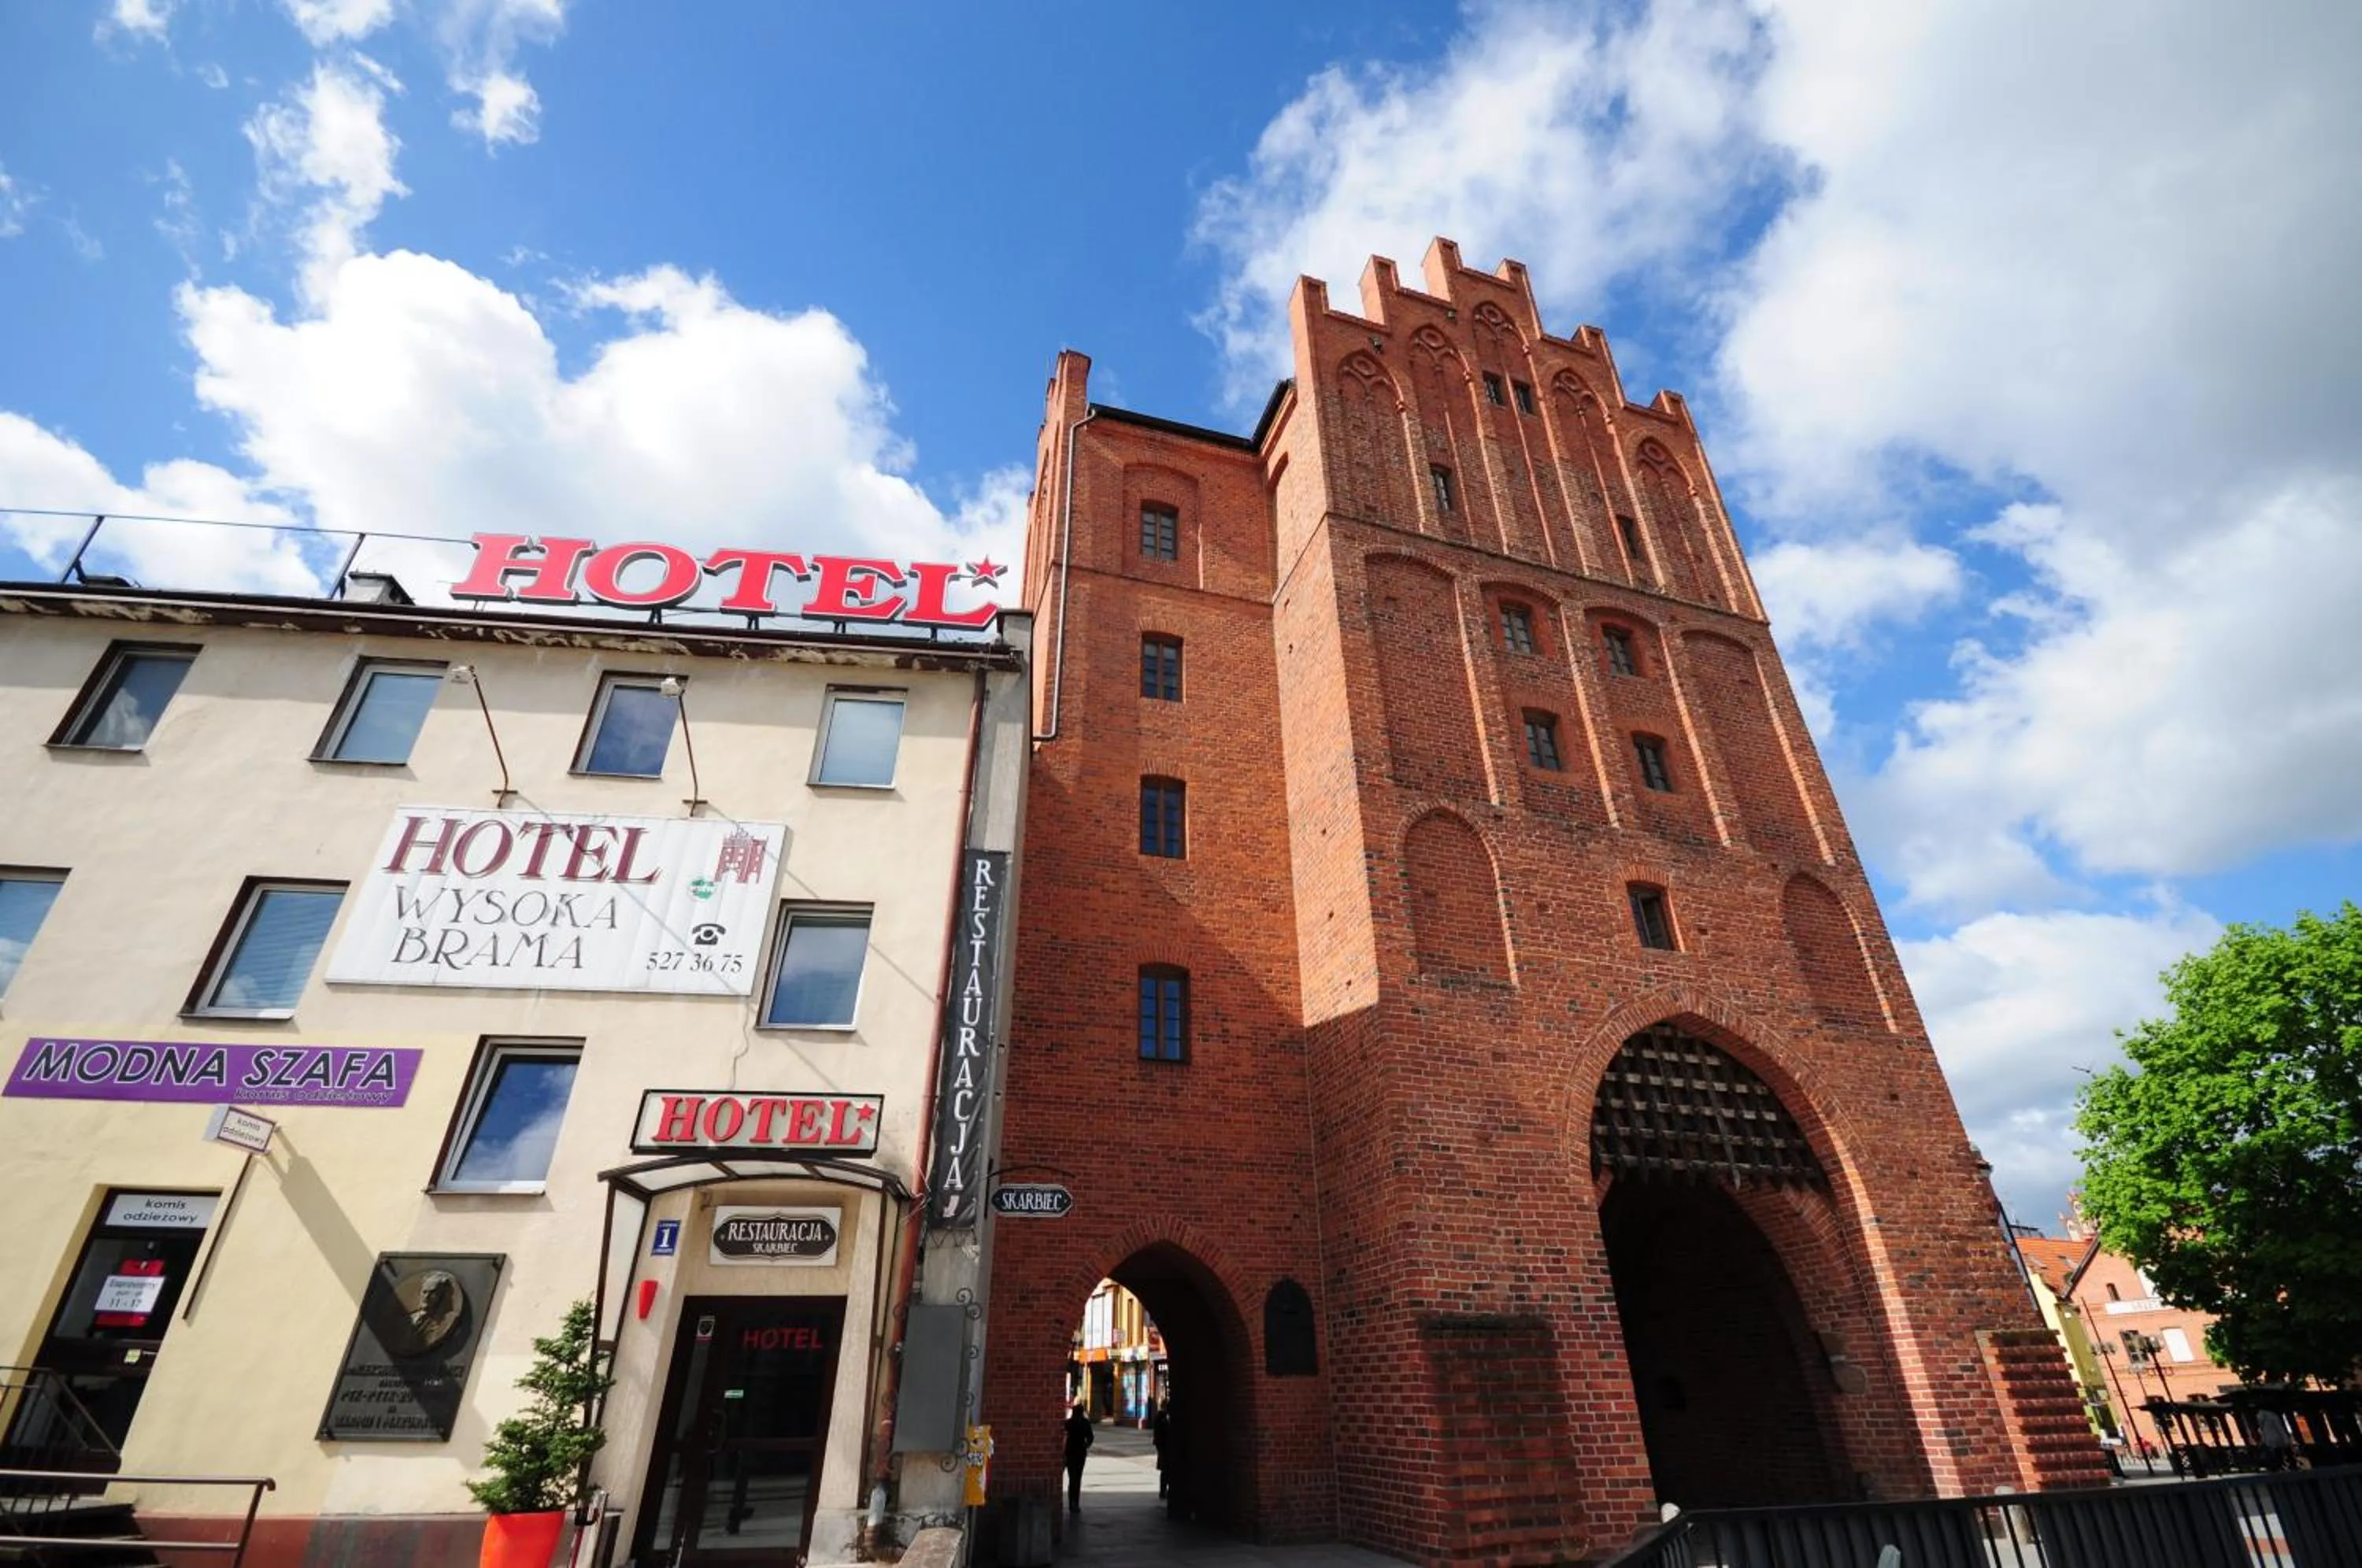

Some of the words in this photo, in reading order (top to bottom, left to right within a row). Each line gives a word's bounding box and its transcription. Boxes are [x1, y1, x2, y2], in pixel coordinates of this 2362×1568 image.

[450, 532, 998, 630] HOTEL
[382, 816, 662, 885] HOTEL
[395, 886, 617, 930] WYSOKA
[392, 926, 583, 970] BRAMA
[646, 952, 684, 971] 527
[690, 953, 713, 971] 36
[720, 955, 742, 974] 75
[943, 859, 995, 1190] RESTAURACJA
[21, 1042, 229, 1086] MODNA
[242, 1048, 395, 1089] SZAFA
[652, 1096, 863, 1145] HOTEL
[145, 1198, 187, 1210] komis
[1001, 1192, 1062, 1210] SKARBIEC
[658, 1227, 669, 1248] 1
[728, 1222, 822, 1241] RESTAURACJA
[752, 1242, 798, 1254] SKARBIEC
[743, 1327, 823, 1349] HOTEL
